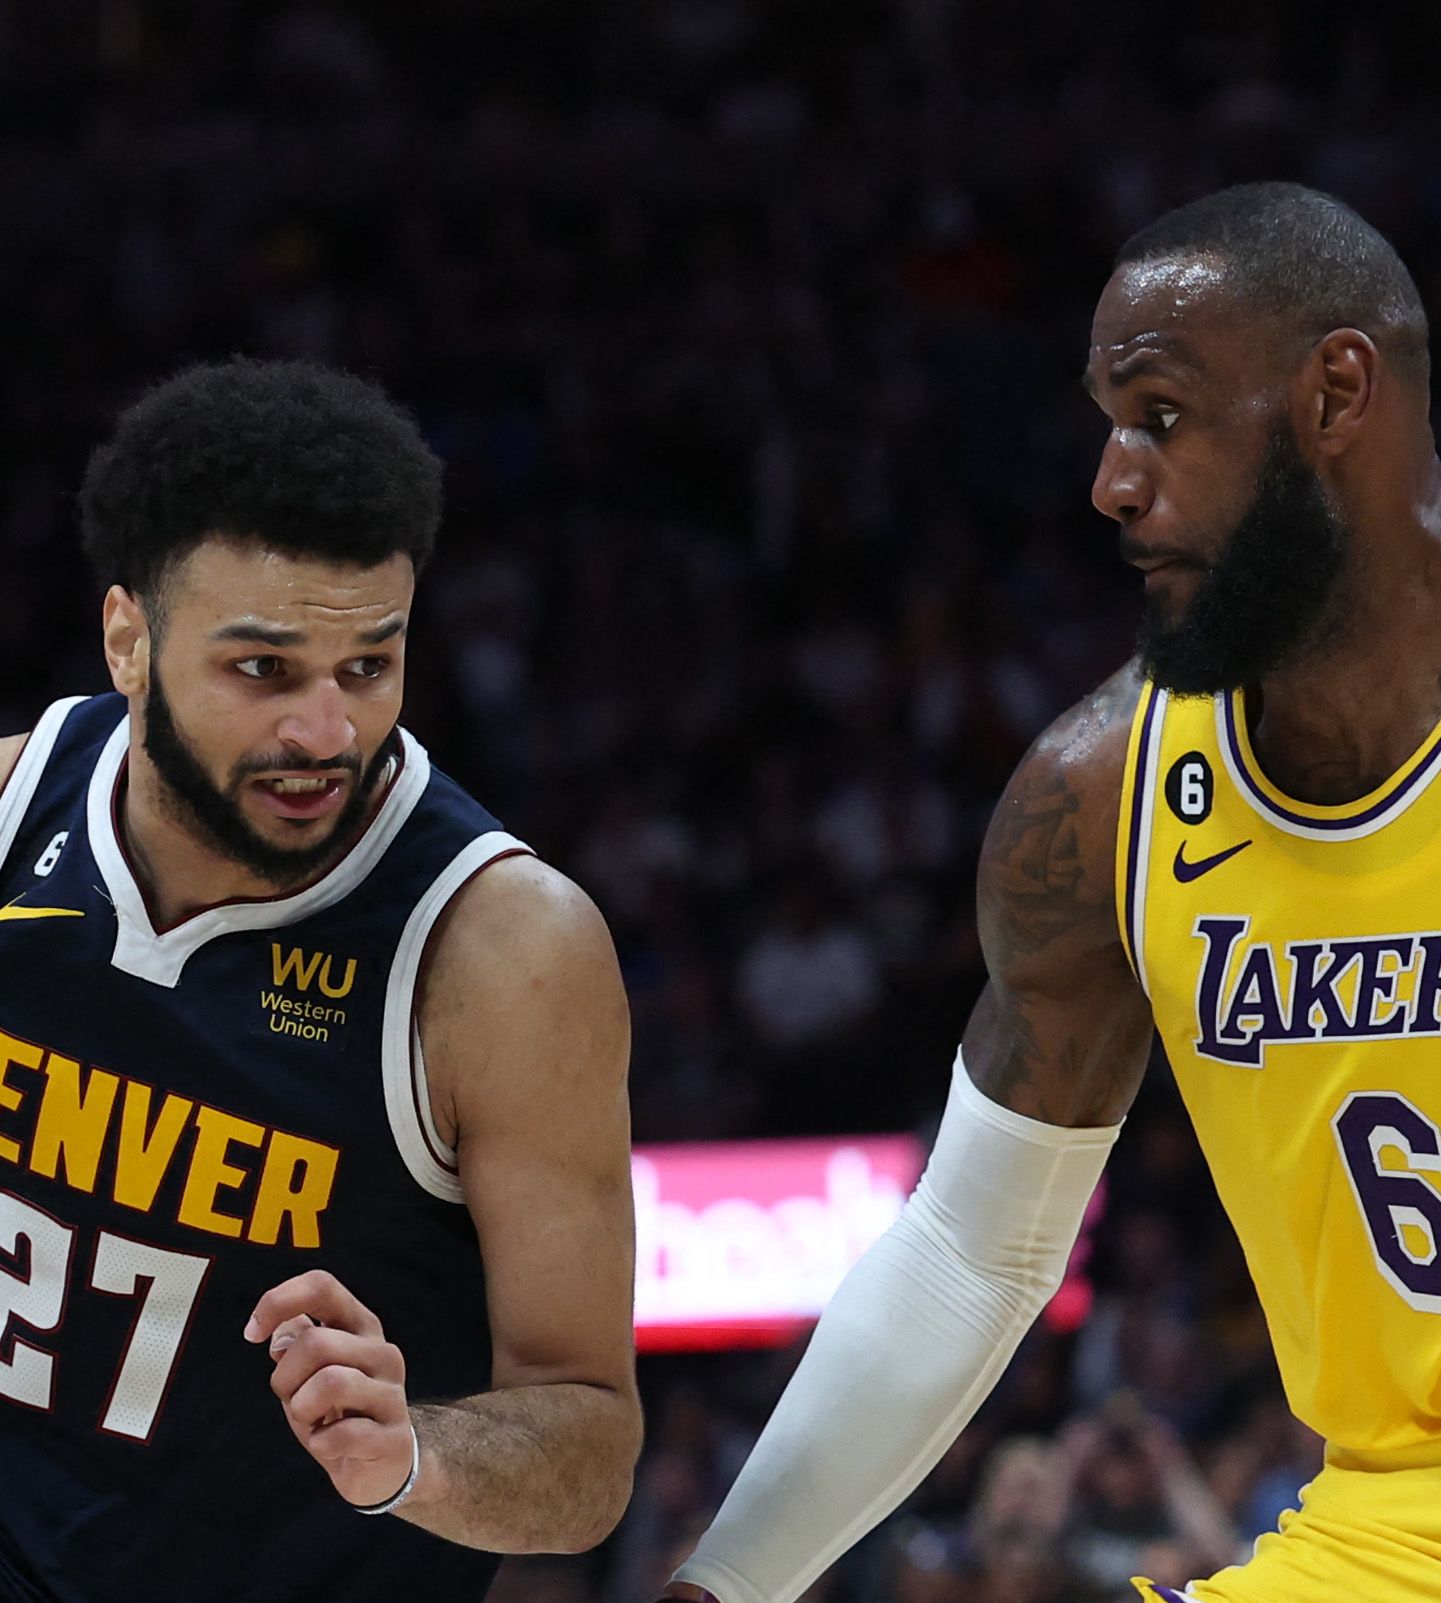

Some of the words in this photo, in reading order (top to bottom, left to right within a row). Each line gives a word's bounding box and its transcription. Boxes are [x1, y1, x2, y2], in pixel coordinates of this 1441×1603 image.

[1180, 762, 1205, 815] 6
[34, 831, 70, 877] 6
[271, 943, 358, 999] WU
[260, 990, 347, 1025] Western
[269, 1013, 329, 1043] Union
